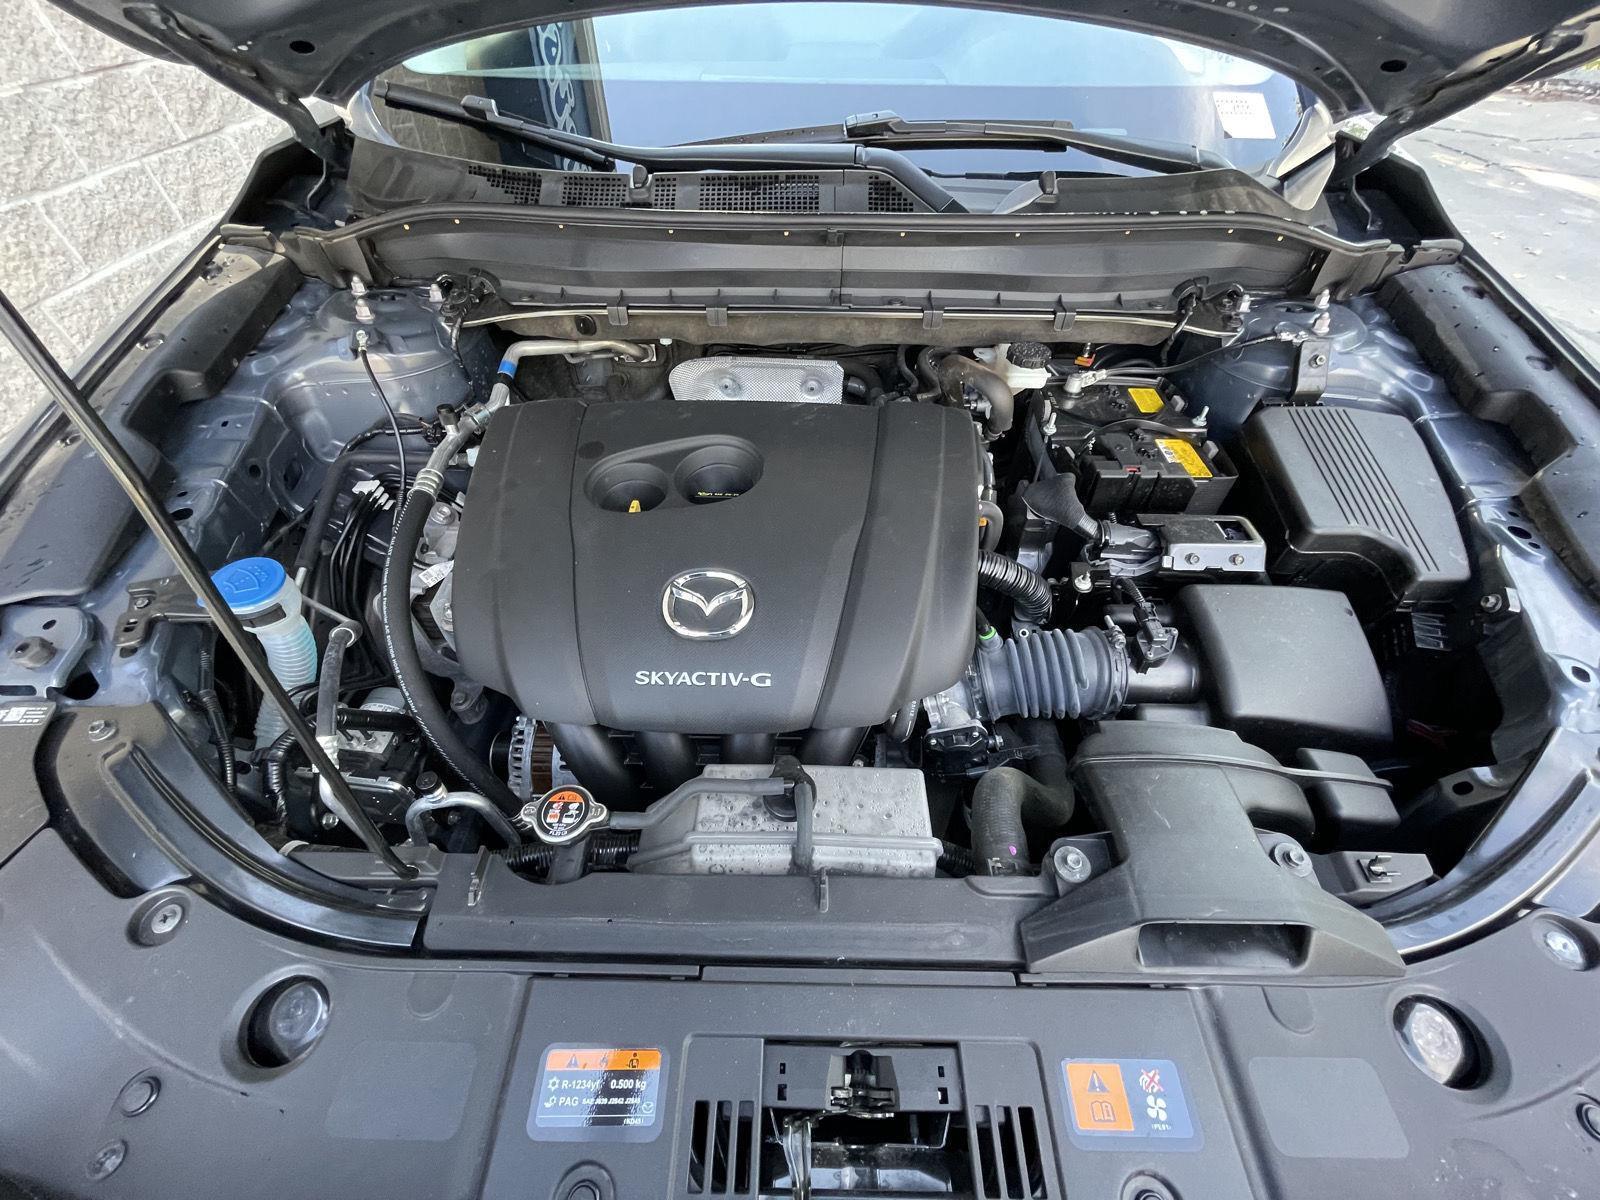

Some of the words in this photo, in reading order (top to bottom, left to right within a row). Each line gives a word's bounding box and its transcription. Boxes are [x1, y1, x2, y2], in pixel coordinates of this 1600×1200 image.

[634, 670, 772, 687] SKYACTIV-G
[561, 1079, 600, 1091] R-1234yf
[610, 1079, 634, 1089] 0.500
[635, 1079, 647, 1090] kg
[559, 1096, 579, 1106] PAG
